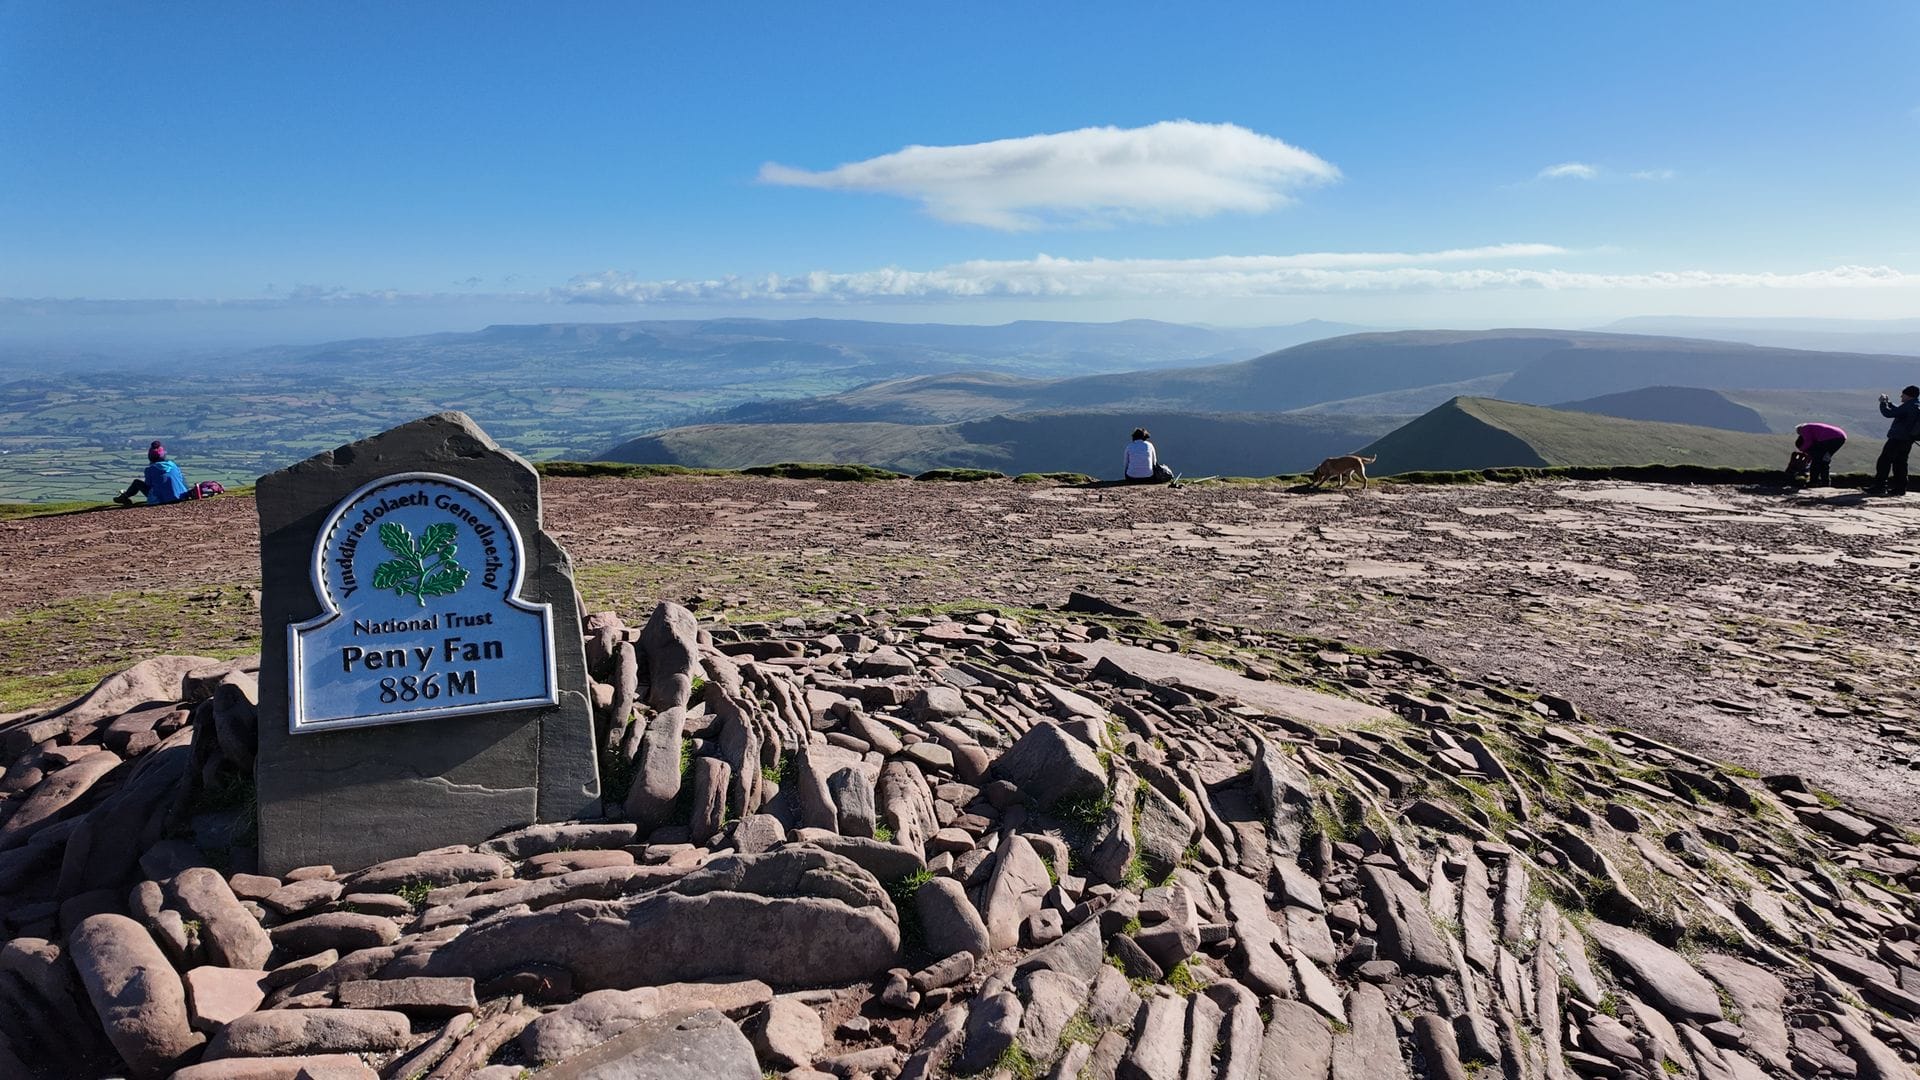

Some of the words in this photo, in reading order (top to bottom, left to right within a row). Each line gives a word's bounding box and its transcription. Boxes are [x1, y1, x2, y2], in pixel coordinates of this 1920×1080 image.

[335, 490, 429, 599] Ymddiriedolaeth
[434, 494, 504, 590] Genedlaethol
[354, 614, 439, 636] National
[444, 612, 493, 628] Trust
[342, 646, 407, 673] Pen
[413, 646, 435, 671] y
[443, 637, 503, 663] Fan
[379, 672, 441, 704] 886
[447, 669, 478, 697] M
